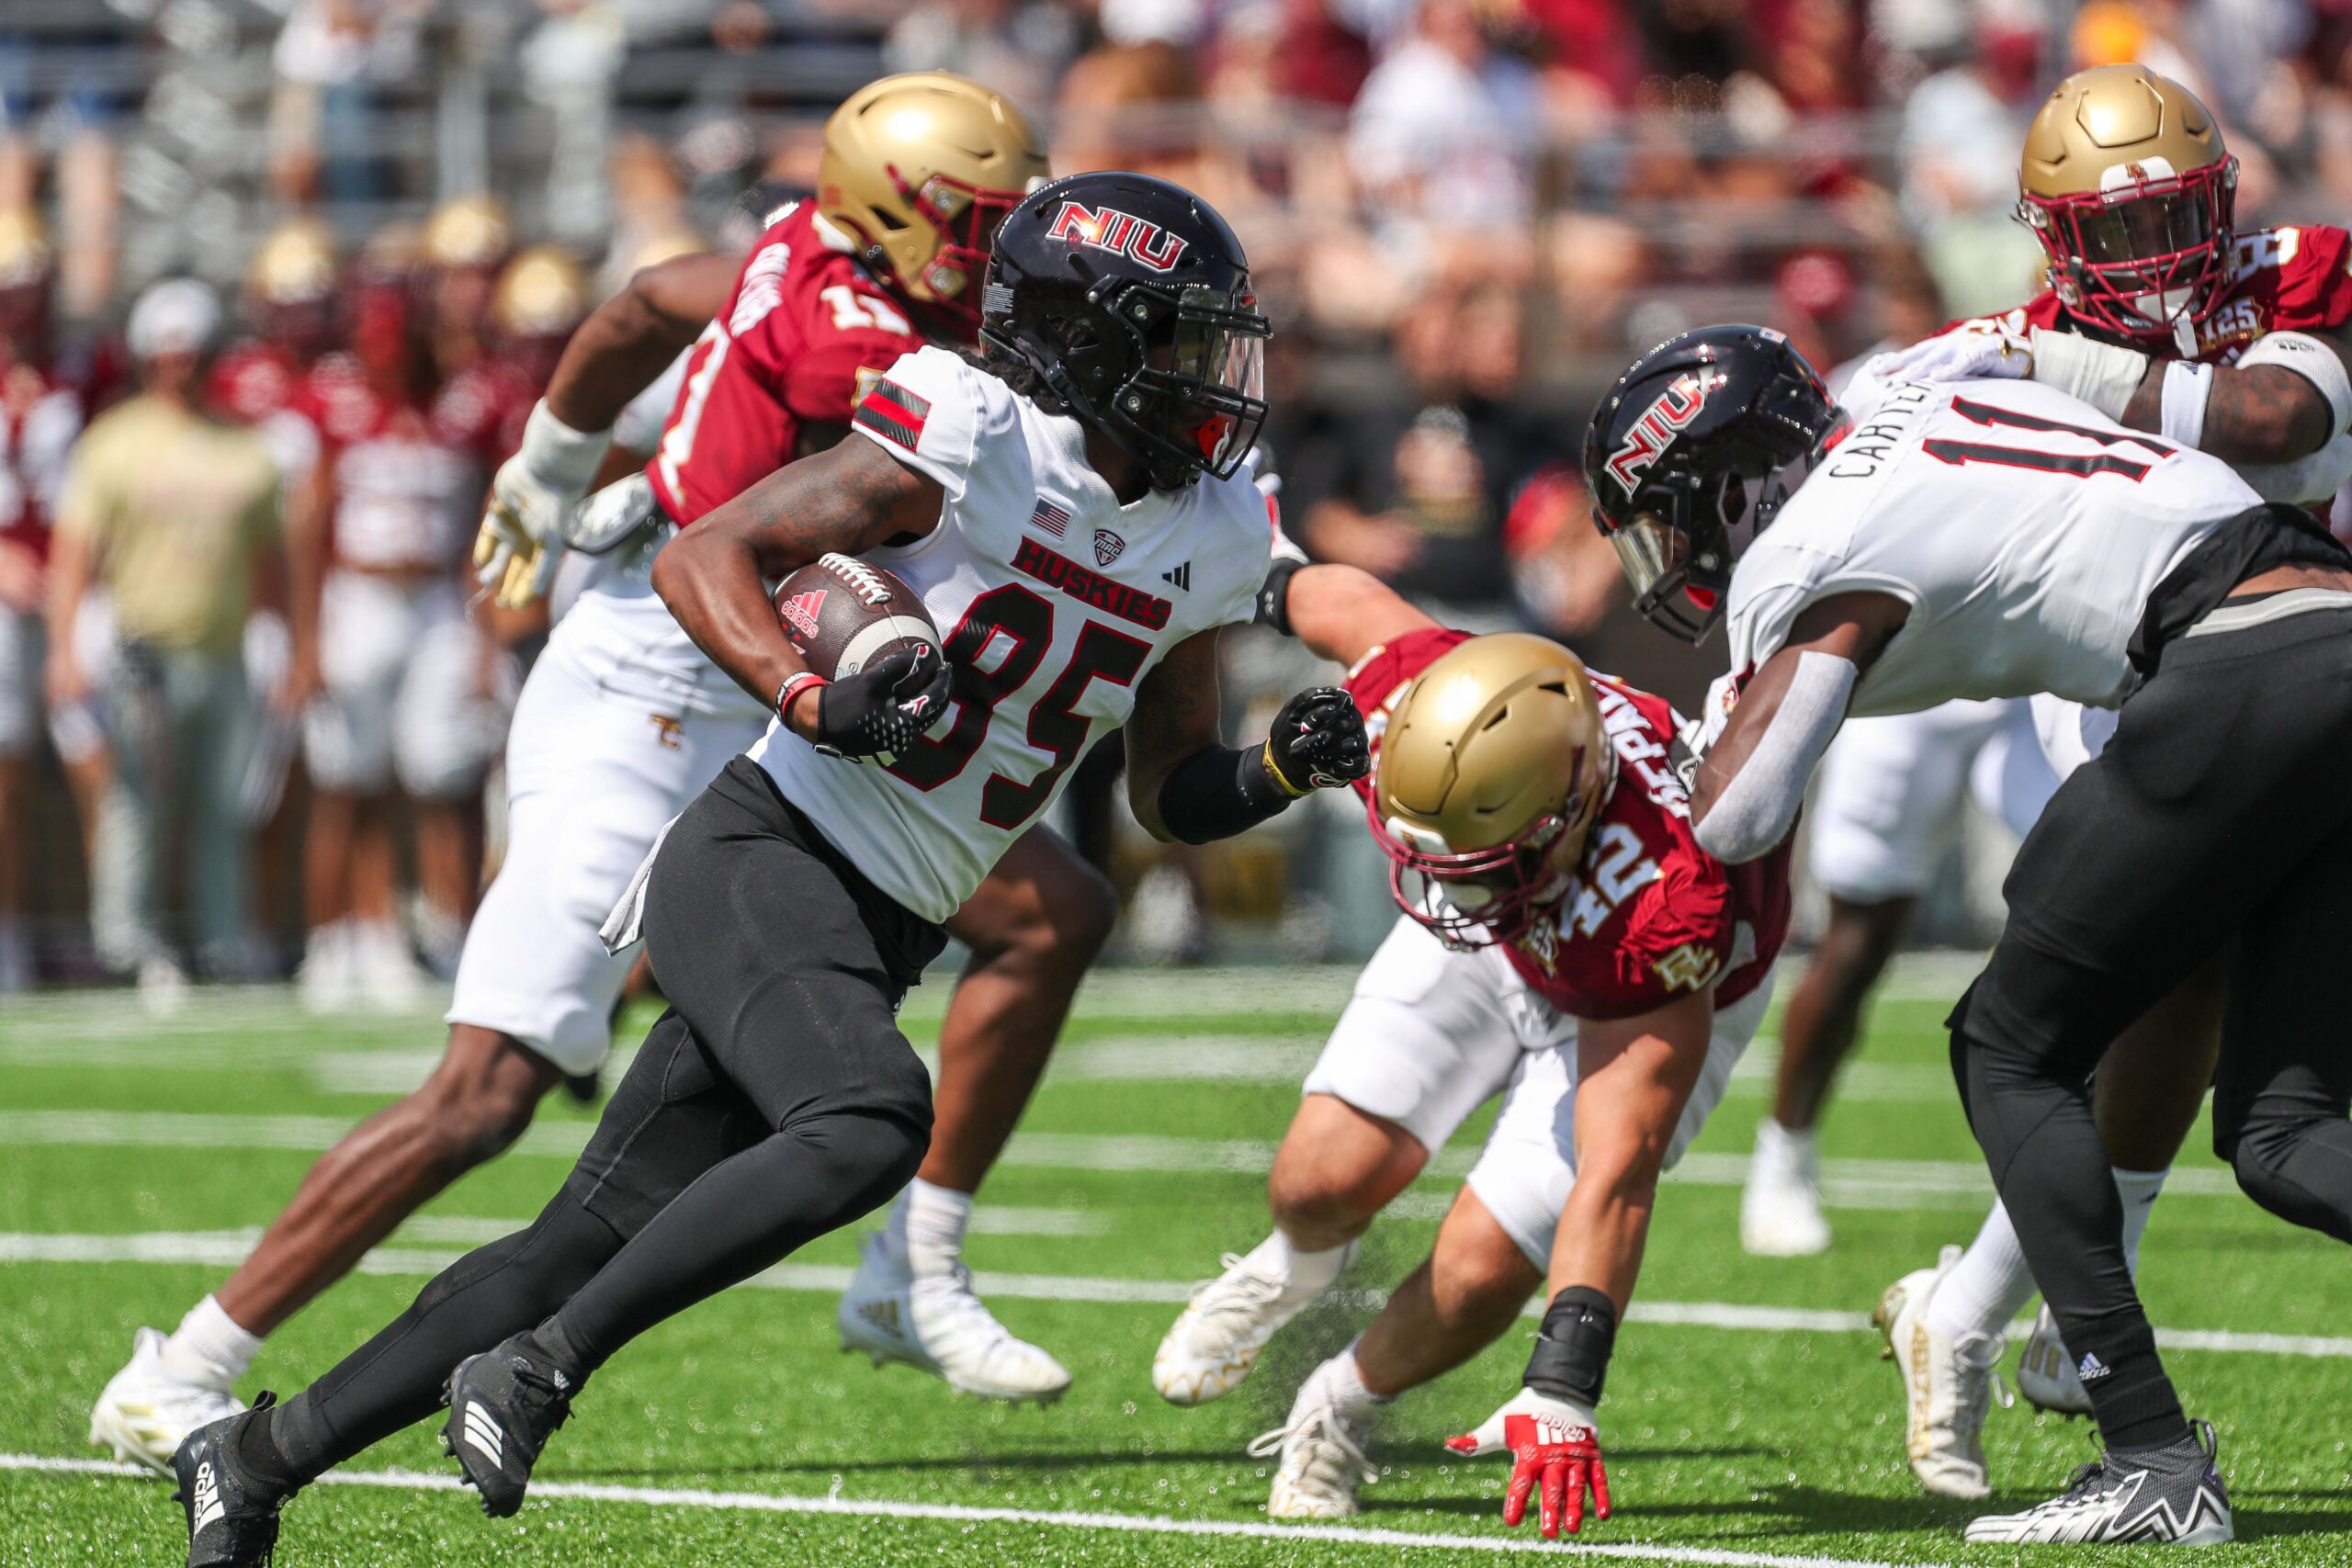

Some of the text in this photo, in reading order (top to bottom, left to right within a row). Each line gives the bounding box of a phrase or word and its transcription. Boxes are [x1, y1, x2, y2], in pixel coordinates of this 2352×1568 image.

[1045, 201, 1189, 273] NIU
[1604, 373, 1705, 499] NIU
[1922, 394, 2178, 483] 11
[1010, 536, 1173, 631] HUSKIES
[1094, 538, 1122, 557] MAC
[781, 600, 820, 639] adidas
[876, 582, 1154, 830] 85
[1557, 822, 1666, 942] 42
